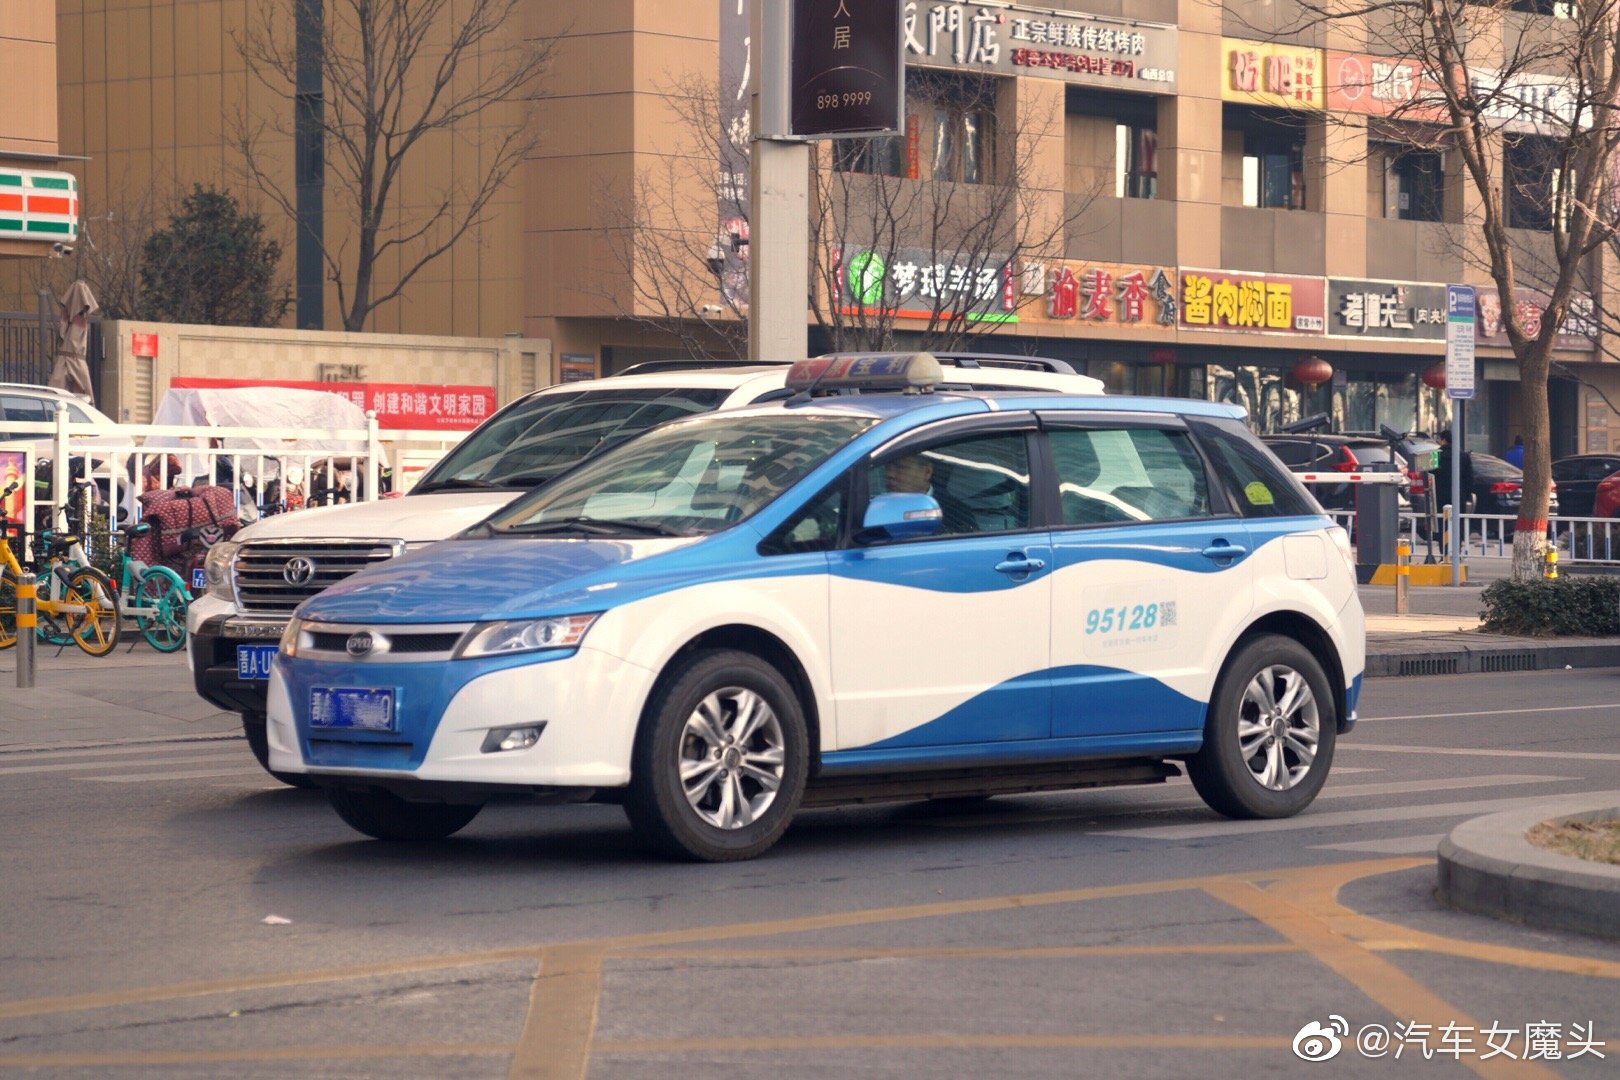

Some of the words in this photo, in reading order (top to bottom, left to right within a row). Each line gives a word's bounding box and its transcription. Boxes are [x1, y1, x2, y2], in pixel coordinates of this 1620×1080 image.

[1013, 18, 1145, 55] 正宗鲜族传统烤肉
[817, 94, 839, 109] 898
[842, 91, 872, 106] 9999
[1185, 275, 1293, 328] 酱肉焖面
[373, 391, 486, 416] 创建和谐文明家园
[1085, 603, 1158, 635] 95128
[240, 650, 276, 674] 晋A·U
